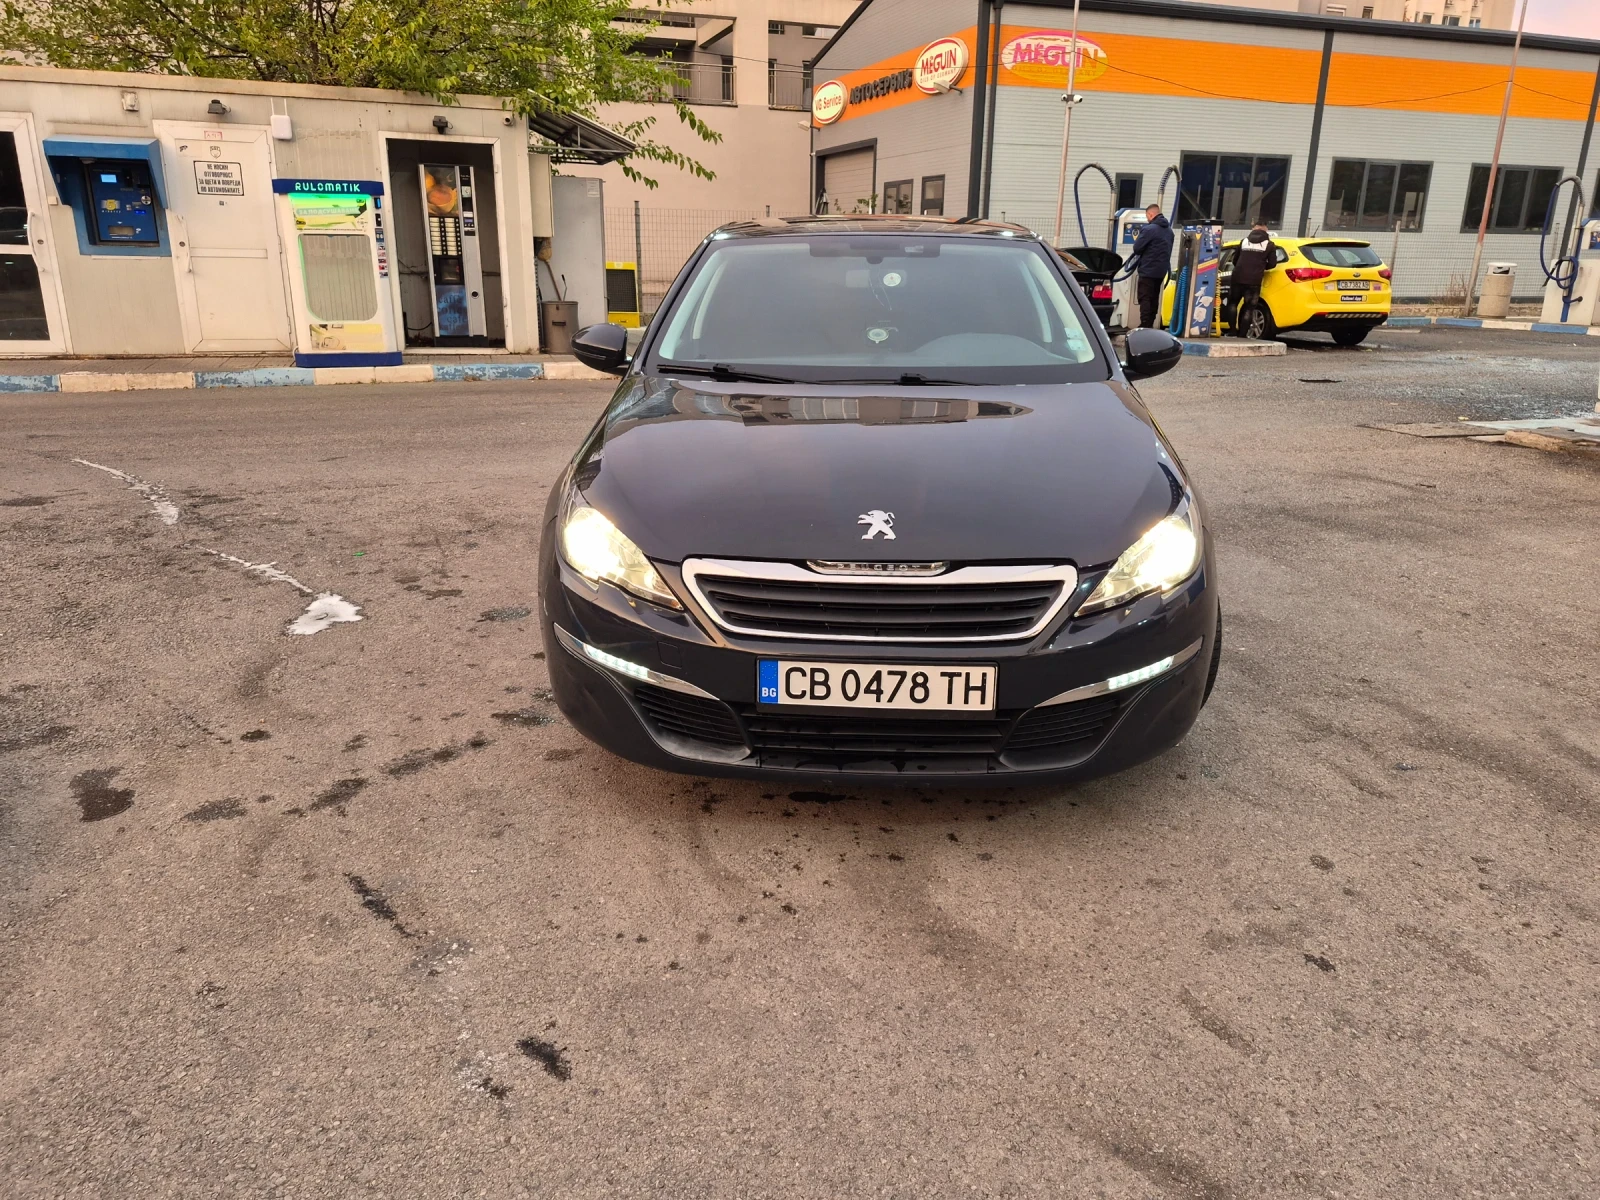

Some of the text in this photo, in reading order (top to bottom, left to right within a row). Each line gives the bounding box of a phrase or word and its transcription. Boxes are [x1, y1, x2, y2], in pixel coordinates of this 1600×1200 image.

[849, 68, 913, 105] АВТОСЕРВИЗ
[815, 93, 842, 112] VG Service
[295, 182, 360, 192] RULOMATIK
[761, 687, 777, 697] BG
[784, 666, 987, 705] CB 0478 TH
